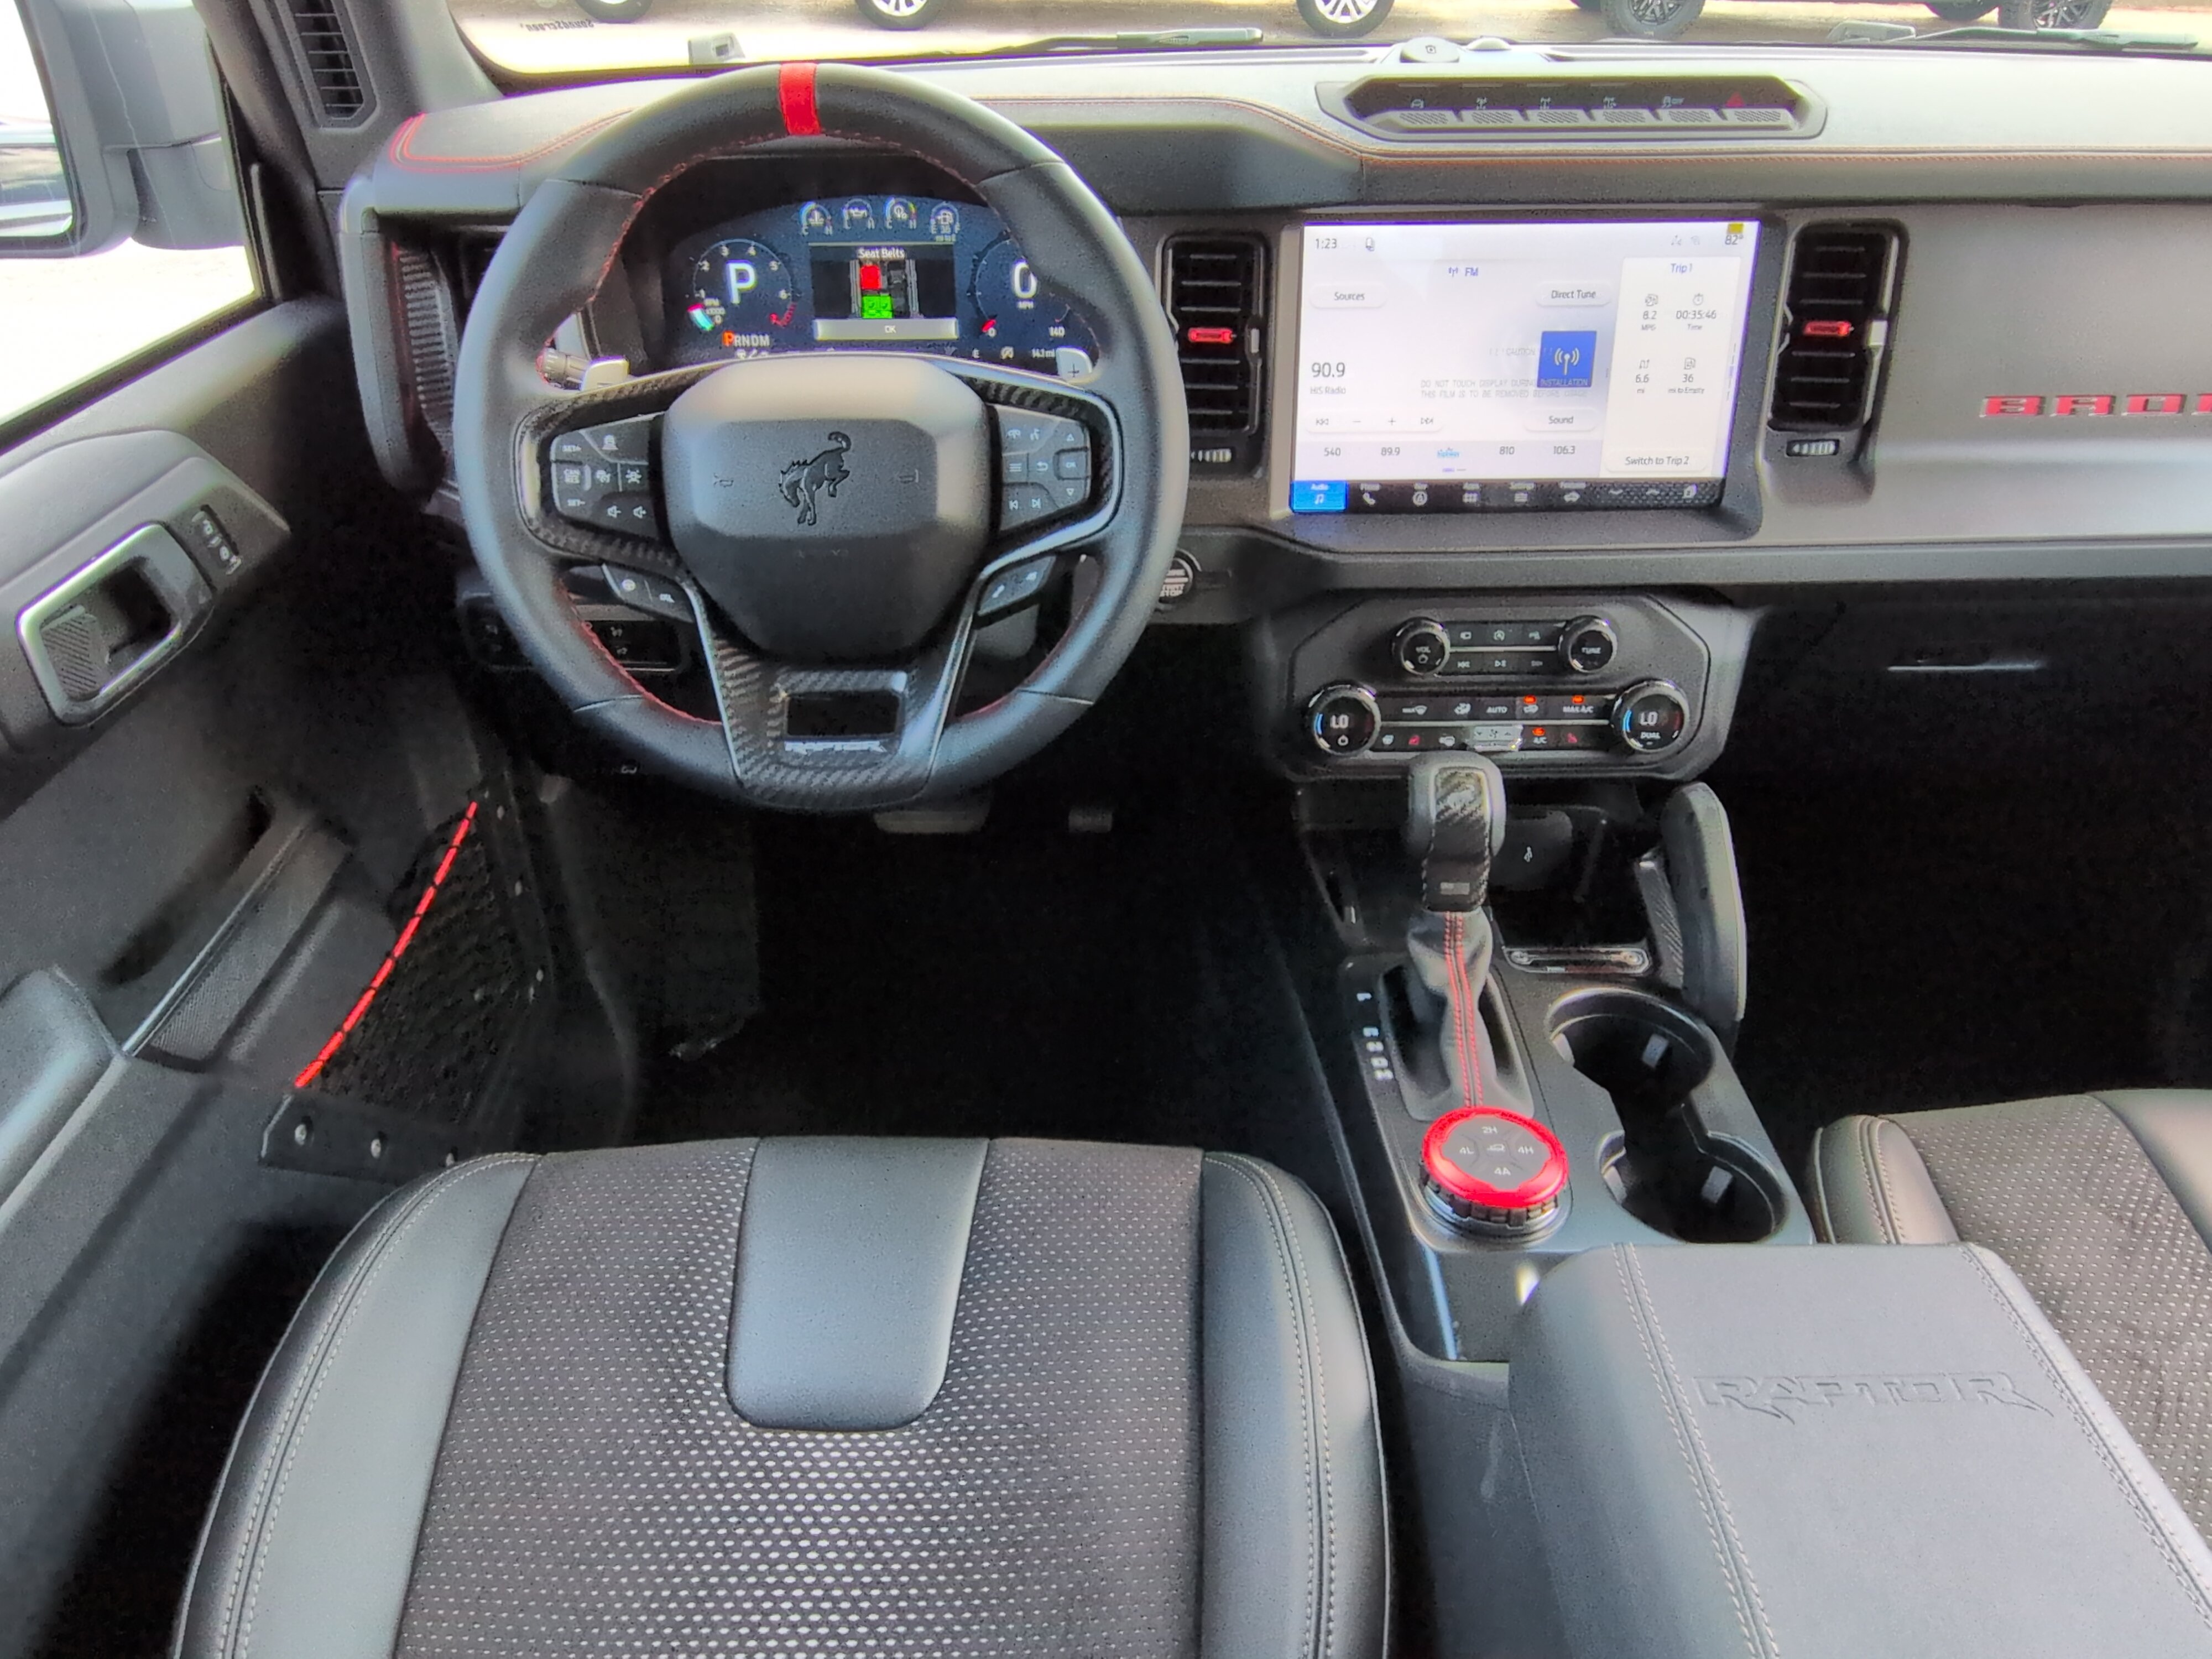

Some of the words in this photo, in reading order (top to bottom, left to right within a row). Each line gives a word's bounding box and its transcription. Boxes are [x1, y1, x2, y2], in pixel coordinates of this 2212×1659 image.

[1315, 238, 1338, 249] 1:23
[721, 246, 729, 257] 3
[748, 245, 756, 256] 4
[858, 248, 880, 259] Seat
[881, 247, 906, 259] Belts
[1464, 267, 1479, 277] FM
[1671, 263, 1687, 274] Trip
[725, 260, 757, 304] P
[1334, 291, 1365, 301] Sources
[1551, 290, 1574, 300] Direct
[1576, 290, 1597, 299] Tune
[1642, 310, 1657, 320] 8.2
[1676, 310, 1717, 320] 00:35:46
[1311, 362, 1346, 378] 90.9
[1635, 374, 1650, 383] 6.6
[1682, 374, 1694, 383] 36
[1421, 380, 1431, 388] DO
[1326, 385, 1346, 395] Radio
[1421, 390, 1436, 398] THIS
[1439, 390, 1455, 398] FILM
[1980, 393, 2212, 418] BRO
[1548, 416, 1574, 425] Sound
[1323, 447, 1341, 457] 540
[1499, 446, 1515, 456] 810
[1553, 446, 1575, 455] 106.3
[1625, 456, 1653, 466] Switch
[1655, 456, 1664, 465] to
[1666, 456, 1683, 467] Trip
[1683, 457, 1689, 465] 2
[1486, 706, 1509, 714] AUTO
[1330, 714, 1350, 729] LO
[1640, 711, 1658, 726] LO
[1481, 1125, 1498, 1134] 2H
[1459, 1146, 1475, 1155] 4L
[1517, 1146, 1535, 1155] 4H
[1494, 1167, 1511, 1176] 4A
[1693, 1371, 2053, 1426] RAPTOR
